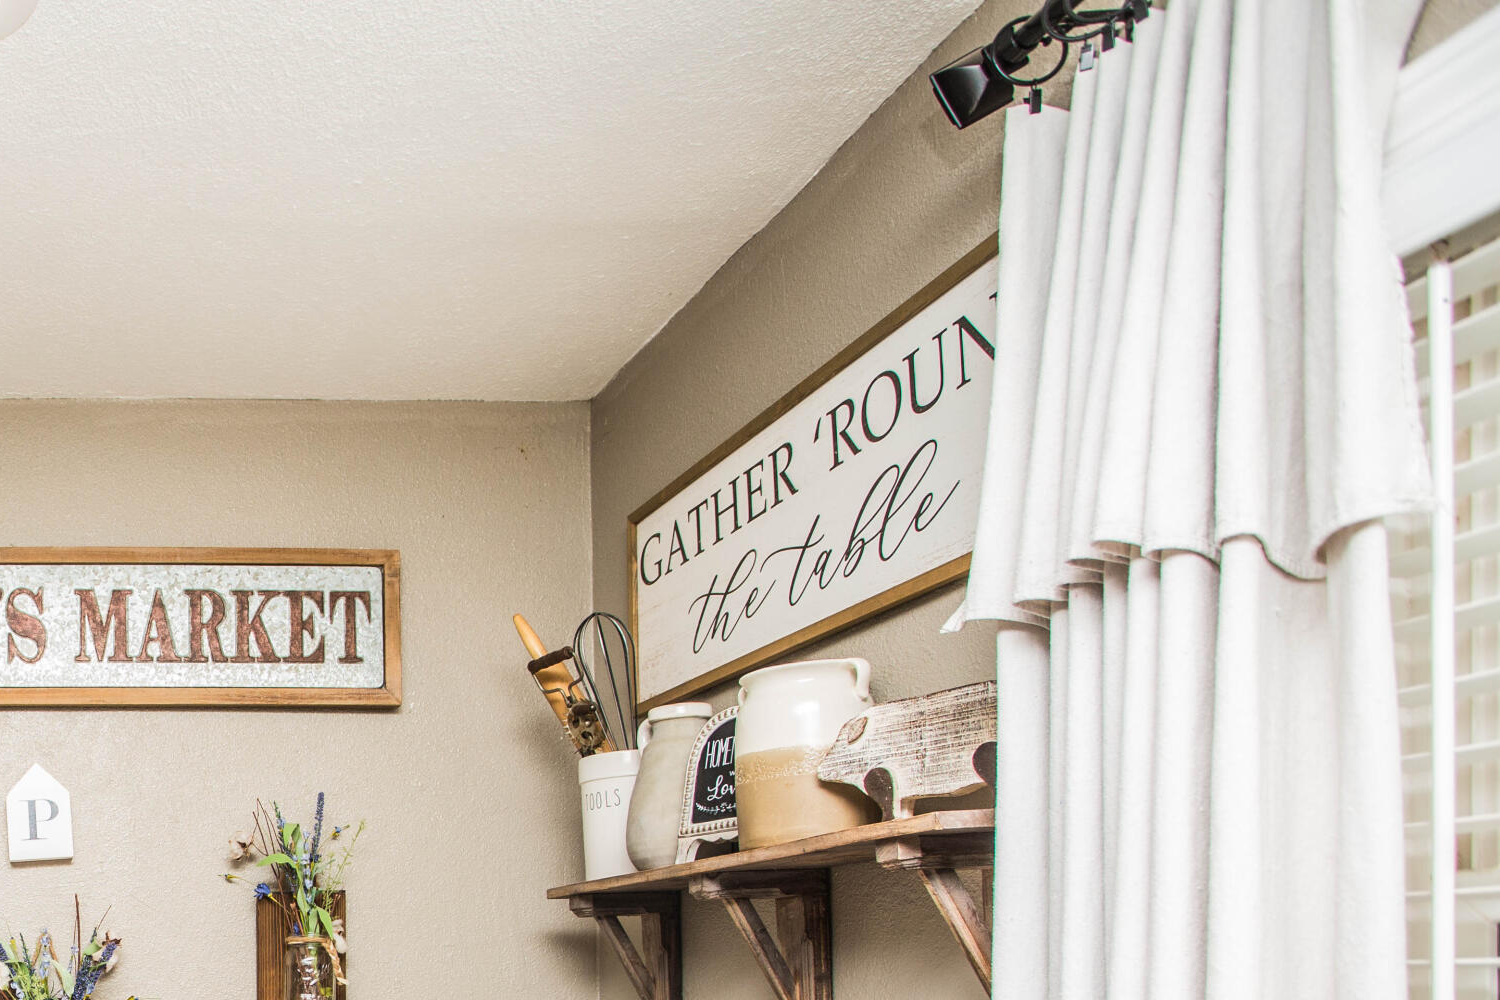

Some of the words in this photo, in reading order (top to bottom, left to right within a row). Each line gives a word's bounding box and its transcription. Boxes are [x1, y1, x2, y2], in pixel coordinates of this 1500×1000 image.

[639, 441, 799, 586] GATHER
[813, 291, 998, 472] 'ROUN
[687, 548, 777, 654] the
[759, 438, 961, 606] table
[74, 587, 372, 664] MARKET
[704, 735, 736, 770] HOME
[585, 788, 621, 811] TOOLS
[706, 774, 736, 802] Lov
[19, 797, 60, 841] P
